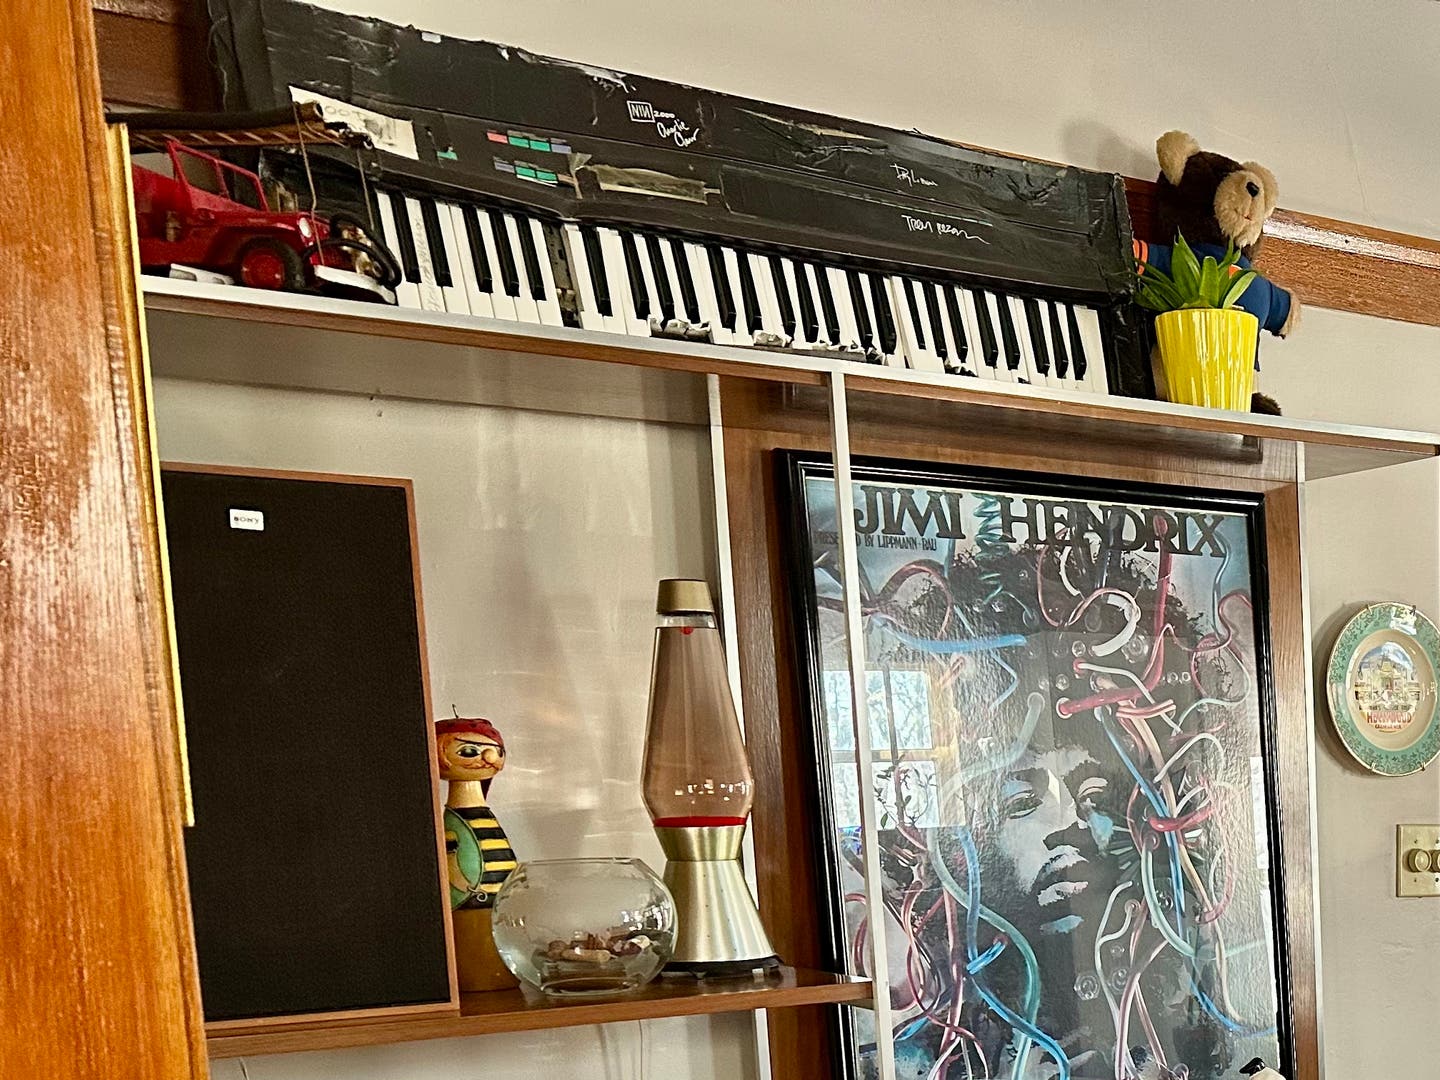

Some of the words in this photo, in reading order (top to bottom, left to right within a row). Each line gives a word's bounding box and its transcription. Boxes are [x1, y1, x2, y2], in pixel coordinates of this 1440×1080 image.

[853, 485, 967, 540] JIMI
[998, 494, 1227, 558] HENDRIX
[865, 535, 874, 547] BY
